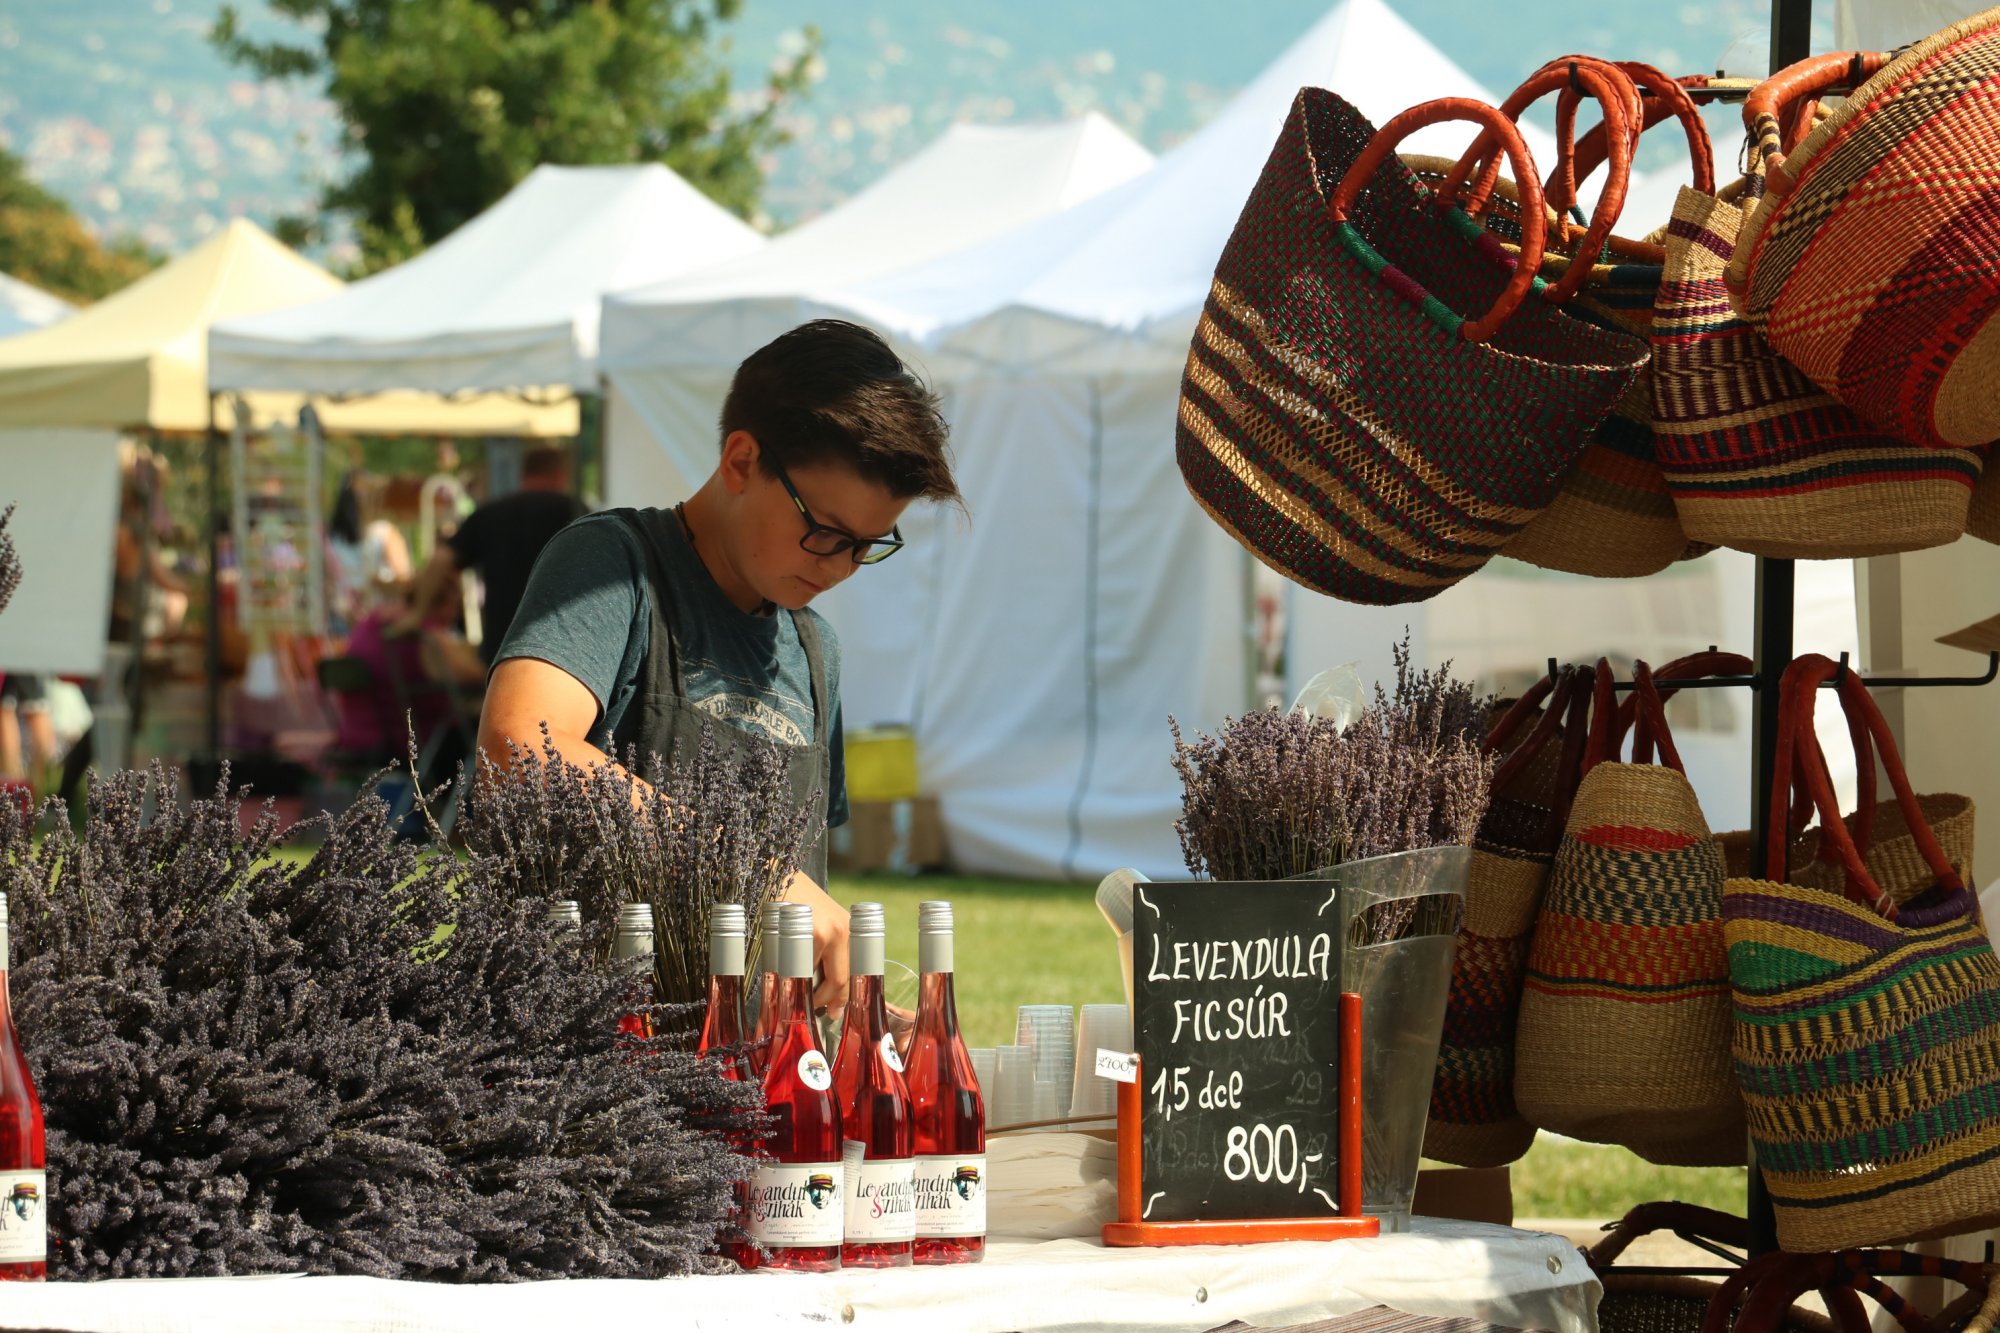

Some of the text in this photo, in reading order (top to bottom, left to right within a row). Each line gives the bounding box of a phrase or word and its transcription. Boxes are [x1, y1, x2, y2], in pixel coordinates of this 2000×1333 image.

[1147, 932, 1331, 982] LEVENDULA
[1171, 984, 1291, 1044] FICSÚR
[1151, 1066, 1191, 1122] 1,5
[1224, 1123, 1323, 1194] 800,-
